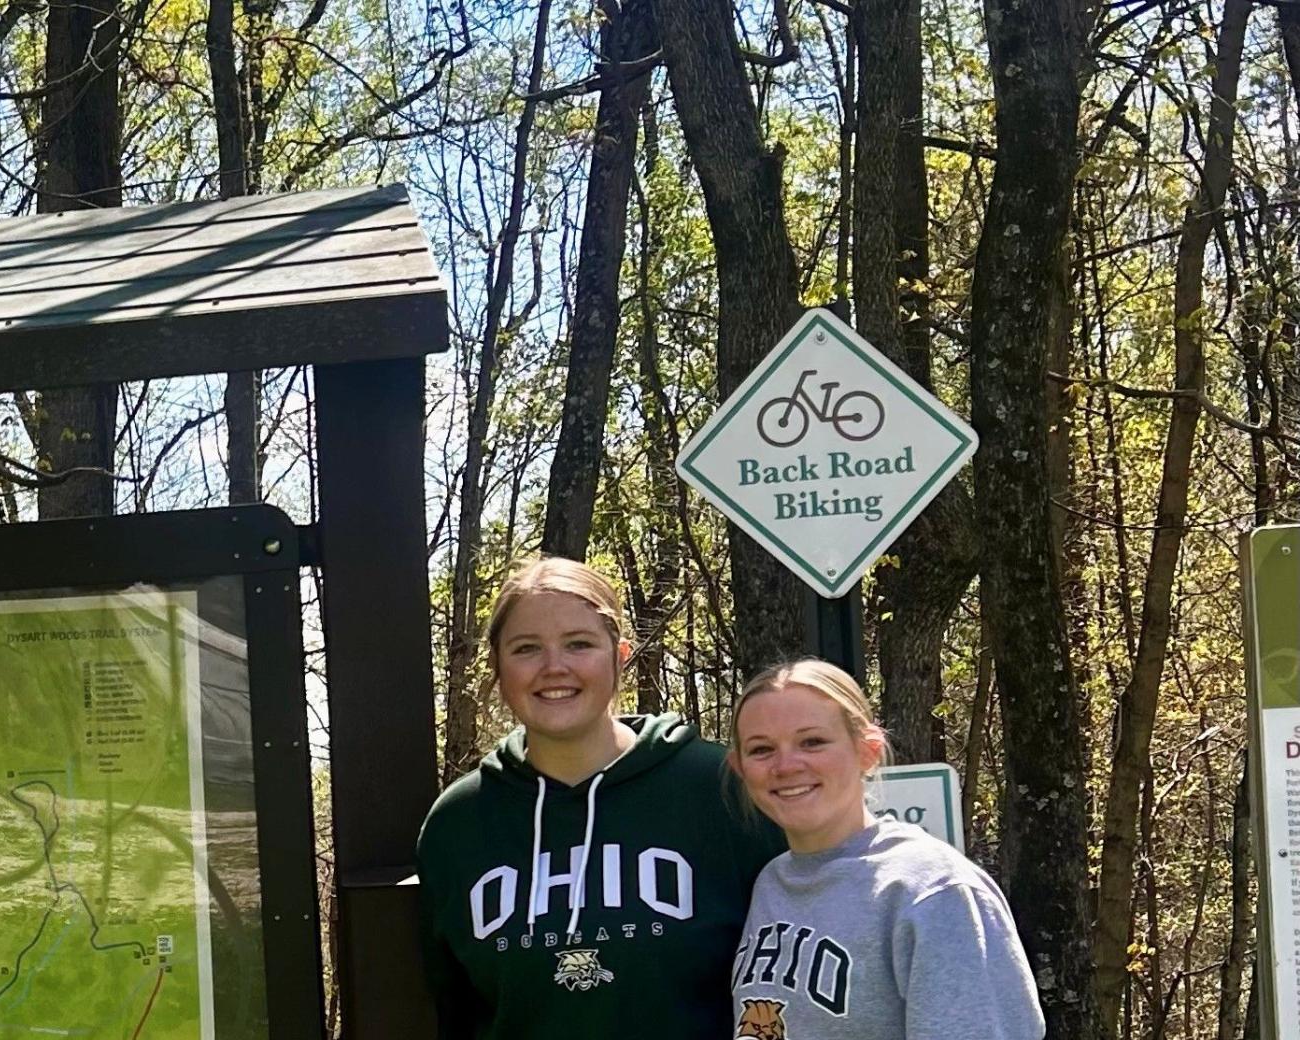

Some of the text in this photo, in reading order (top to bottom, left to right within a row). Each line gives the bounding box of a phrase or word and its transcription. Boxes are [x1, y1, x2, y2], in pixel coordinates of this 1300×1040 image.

[737, 446, 916, 486] Back Road
[773, 489, 883, 521] Biking
[469, 844, 694, 940] OHIO
[496, 922, 664, 951] BOBCATS
